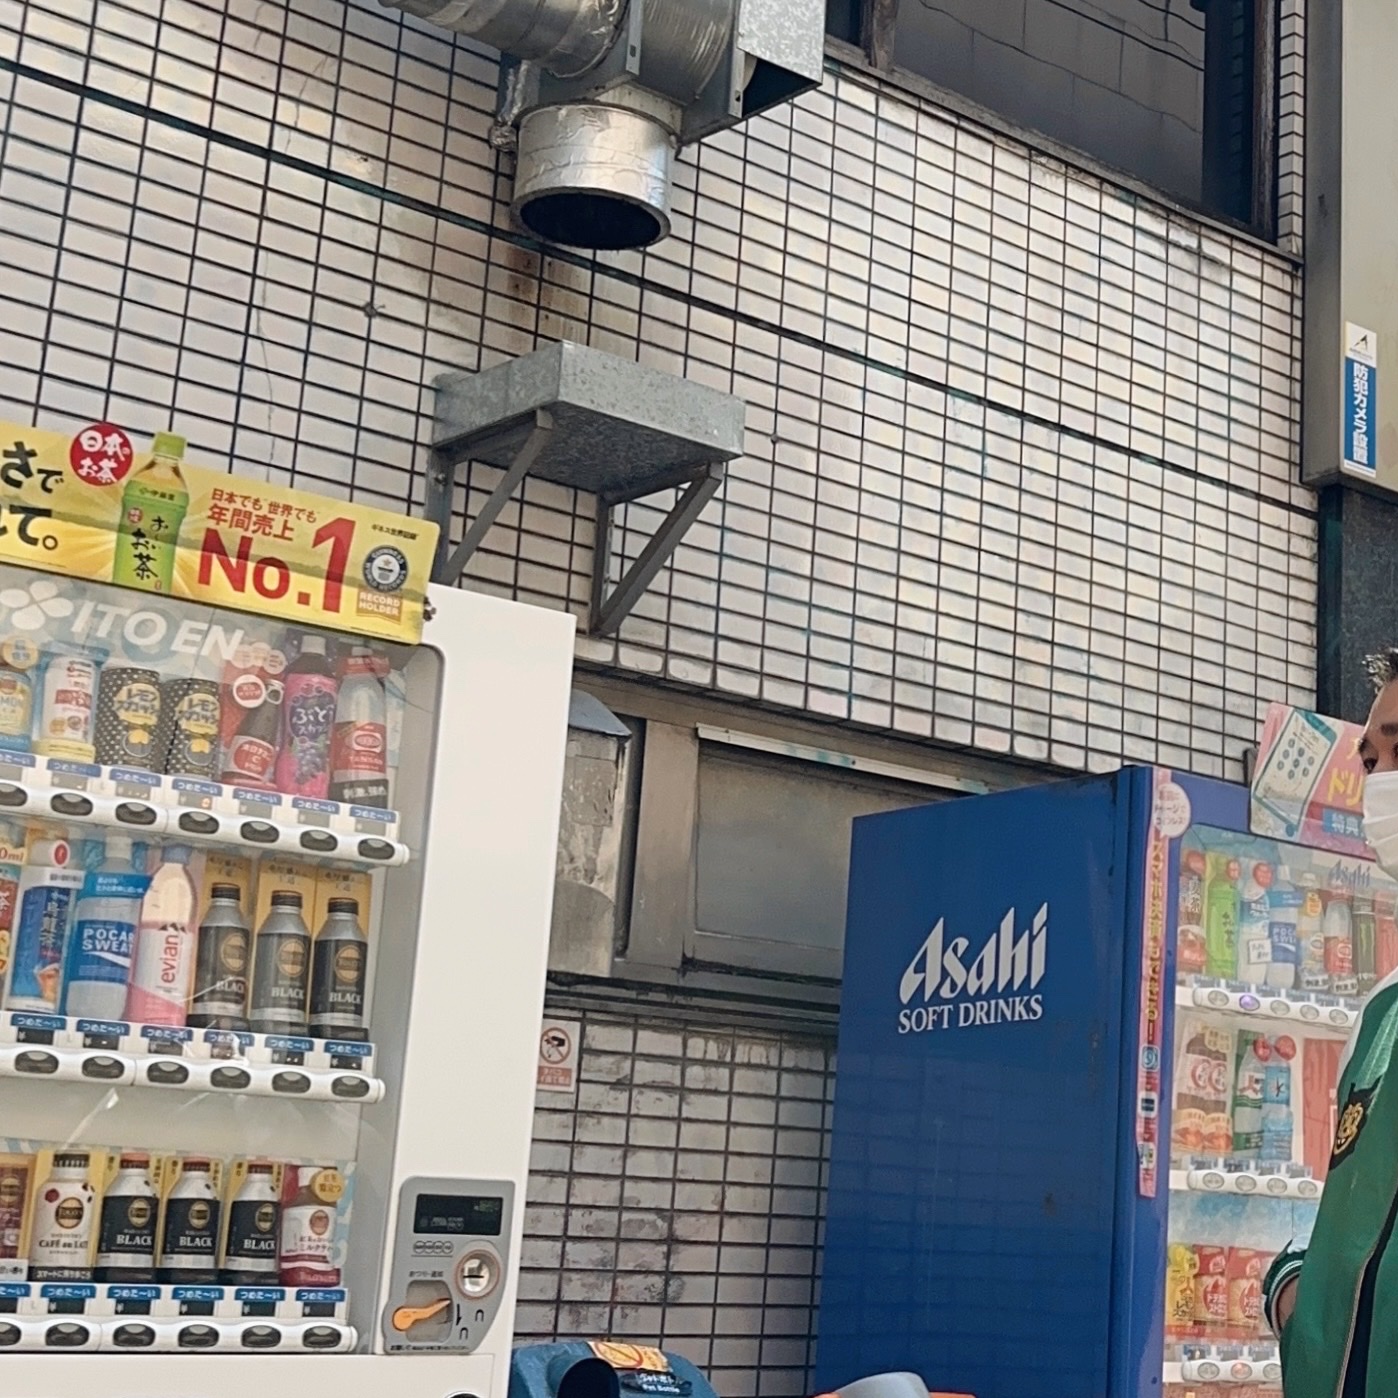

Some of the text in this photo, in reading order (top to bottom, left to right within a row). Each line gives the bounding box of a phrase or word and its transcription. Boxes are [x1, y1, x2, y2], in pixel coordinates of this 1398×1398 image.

[1353, 362, 1369, 465] 防犯カメラ設置
[0, 503, 59, 551] て。
[206, 503, 296, 543] 年間売上
[197, 516, 357, 614] No.1
[359, 601, 400, 615] HOLDER
[360, 591, 401, 607] RECORD
[71, 600, 244, 662] ITO EN
[160, 933, 180, 984] evian
[899, 902, 1049, 1006] Asahi
[898, 995, 1044, 1035] SOFT DRINKS
[179, 1236, 212, 1248] BLACK
